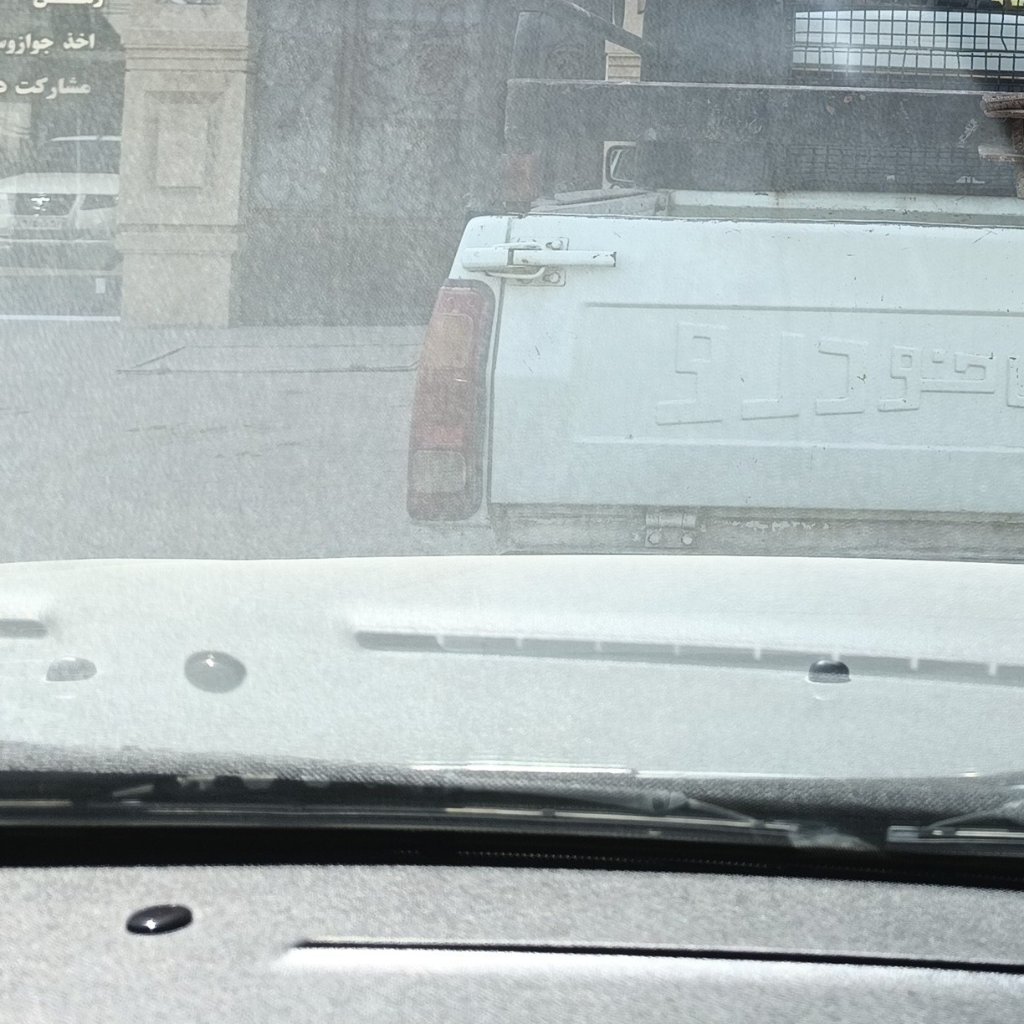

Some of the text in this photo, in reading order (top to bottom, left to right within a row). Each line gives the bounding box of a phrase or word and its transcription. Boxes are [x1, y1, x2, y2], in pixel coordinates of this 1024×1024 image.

[63, 32, 96, 50] اخذ
[15, 77, 91, 99] مشارکت
[655, 322, 993, 426] خودرو
